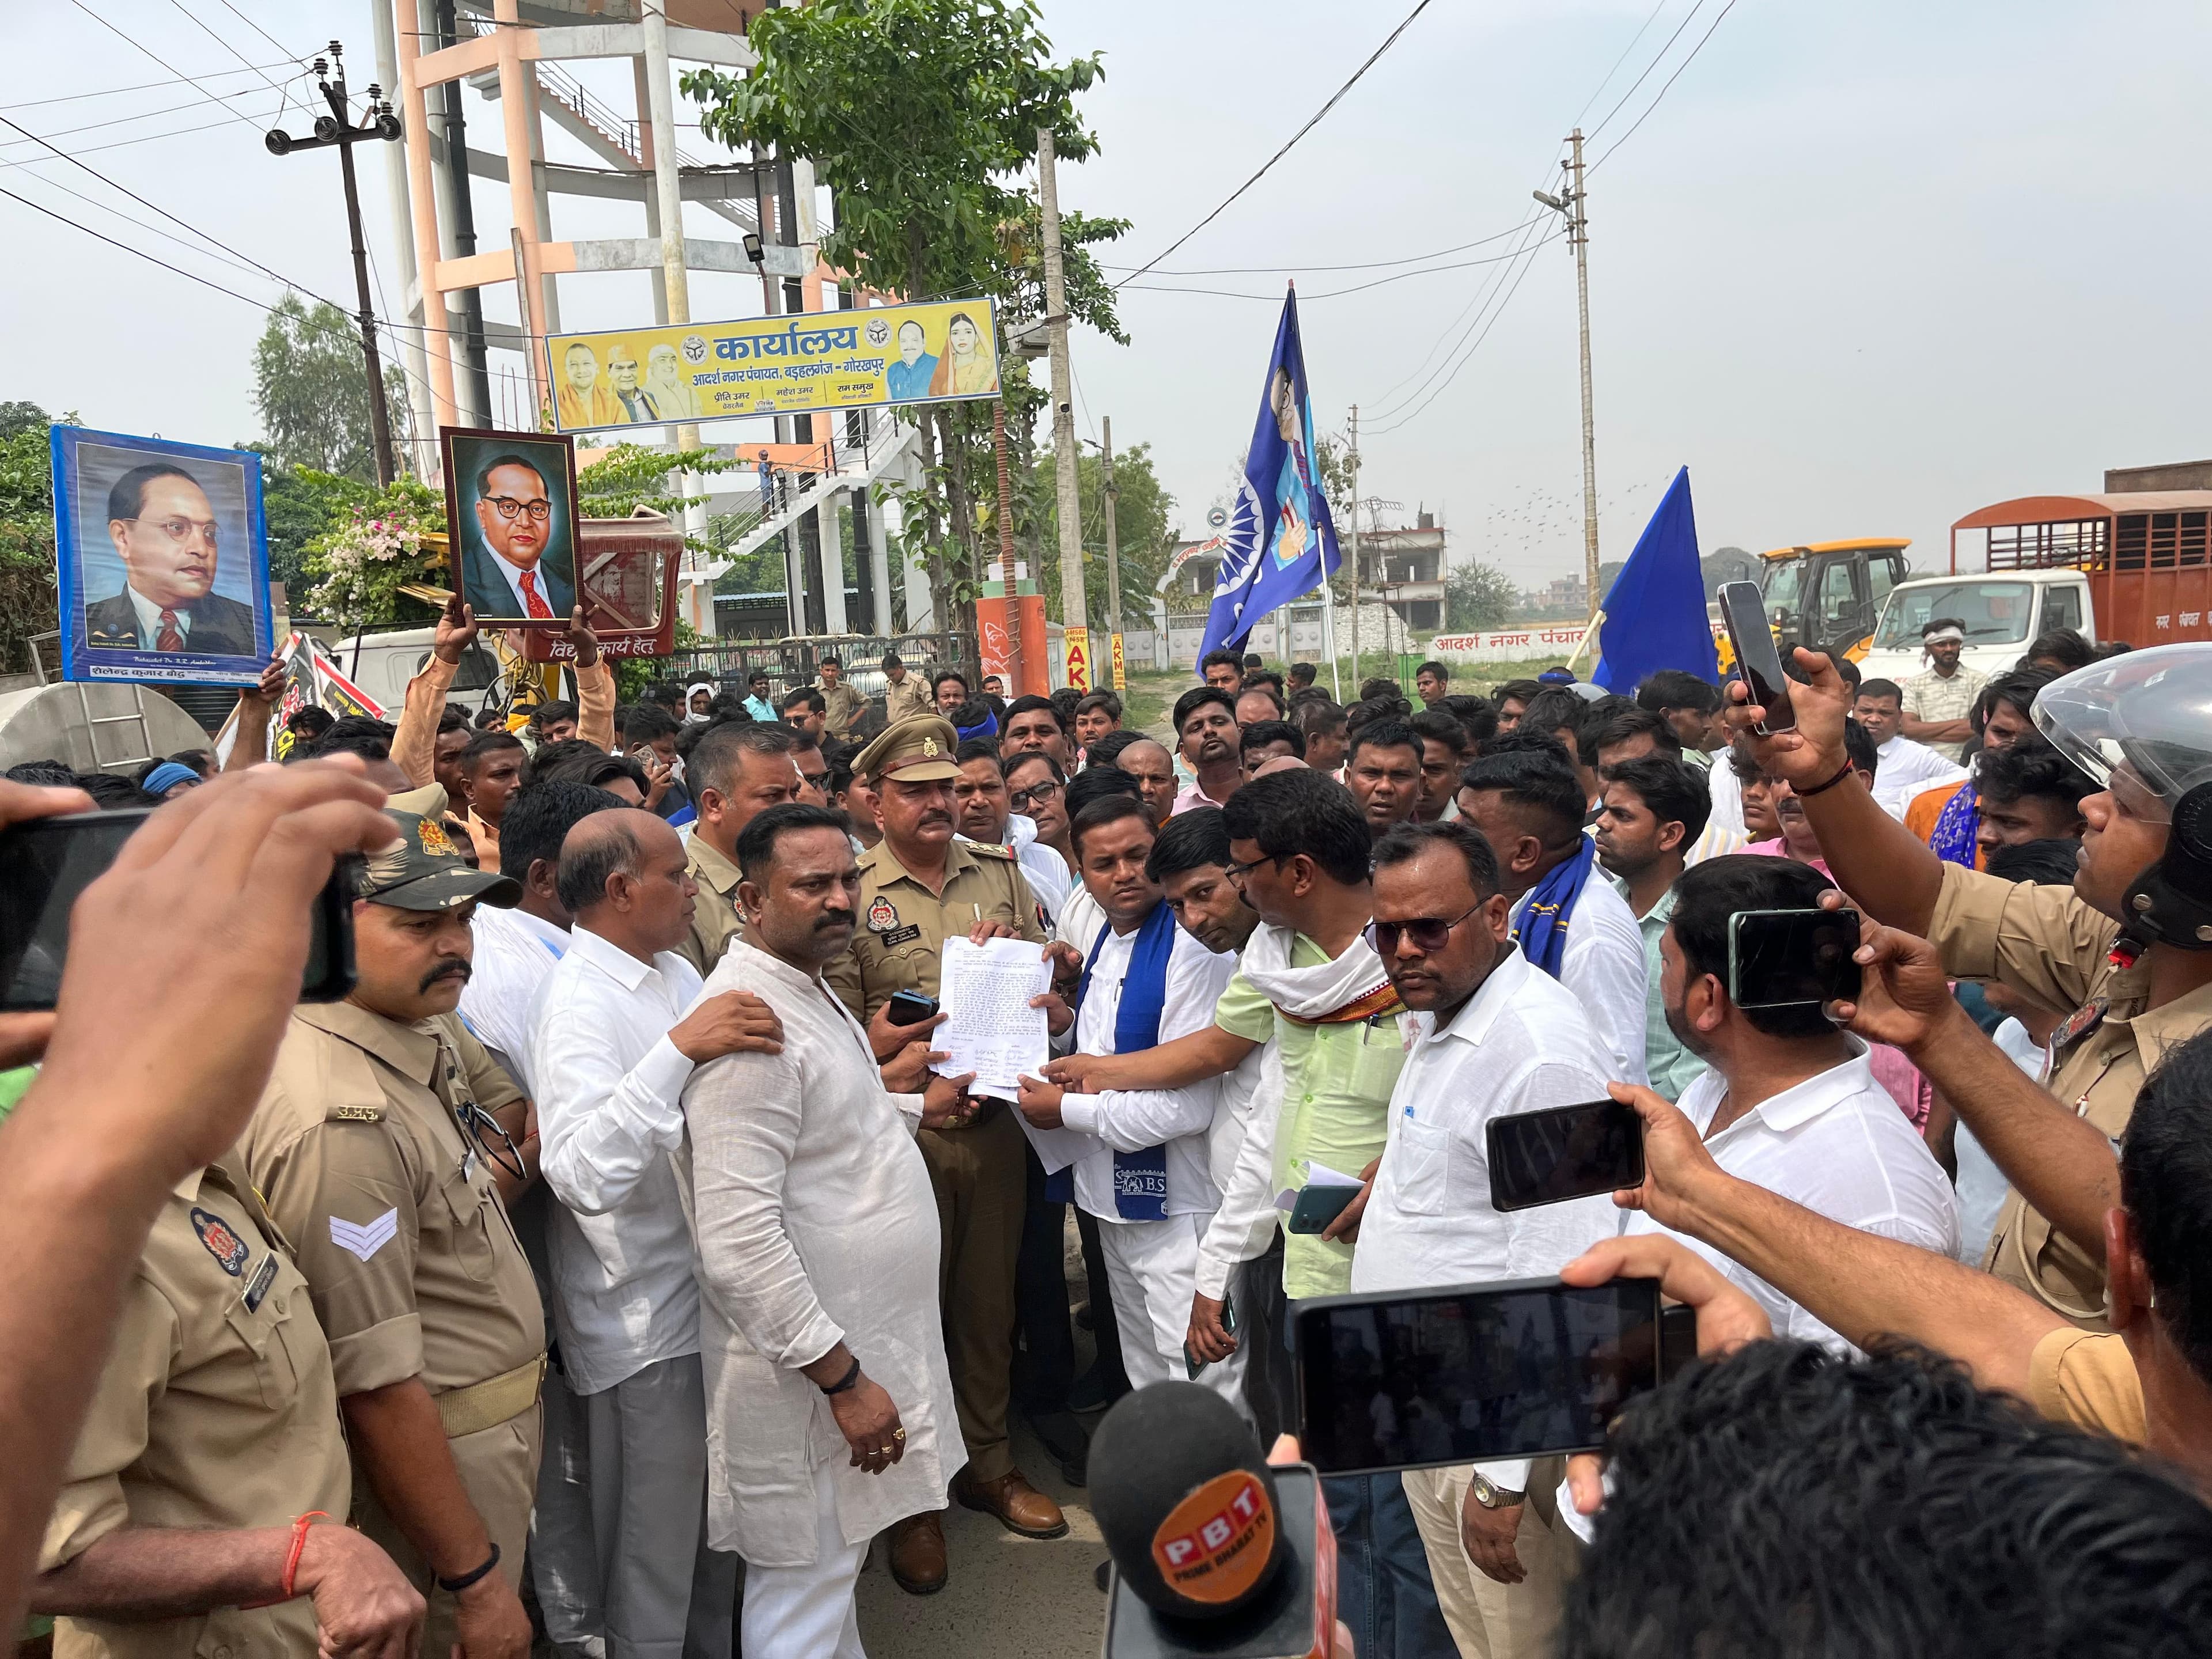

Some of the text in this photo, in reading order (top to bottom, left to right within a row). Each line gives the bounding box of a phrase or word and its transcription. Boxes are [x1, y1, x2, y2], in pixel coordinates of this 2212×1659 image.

[713, 322, 858, 360] कार्यालय
[692, 368, 720, 386] आदर्श
[722, 371, 745, 383] नगर
[747, 366, 782, 381] पंचायत,
[843, 357, 885, 376] गोरखपुर
[714, 392, 750, 402] प्रीति उमर
[776, 387, 795, 396] महेश
[633, 635, 657, 656] हेतु
[1435, 630, 1586, 651] आदर्श नगर पंचाय
[1113, 641, 1123, 671] AKM
[1165, 1486, 1253, 1566] PBT
